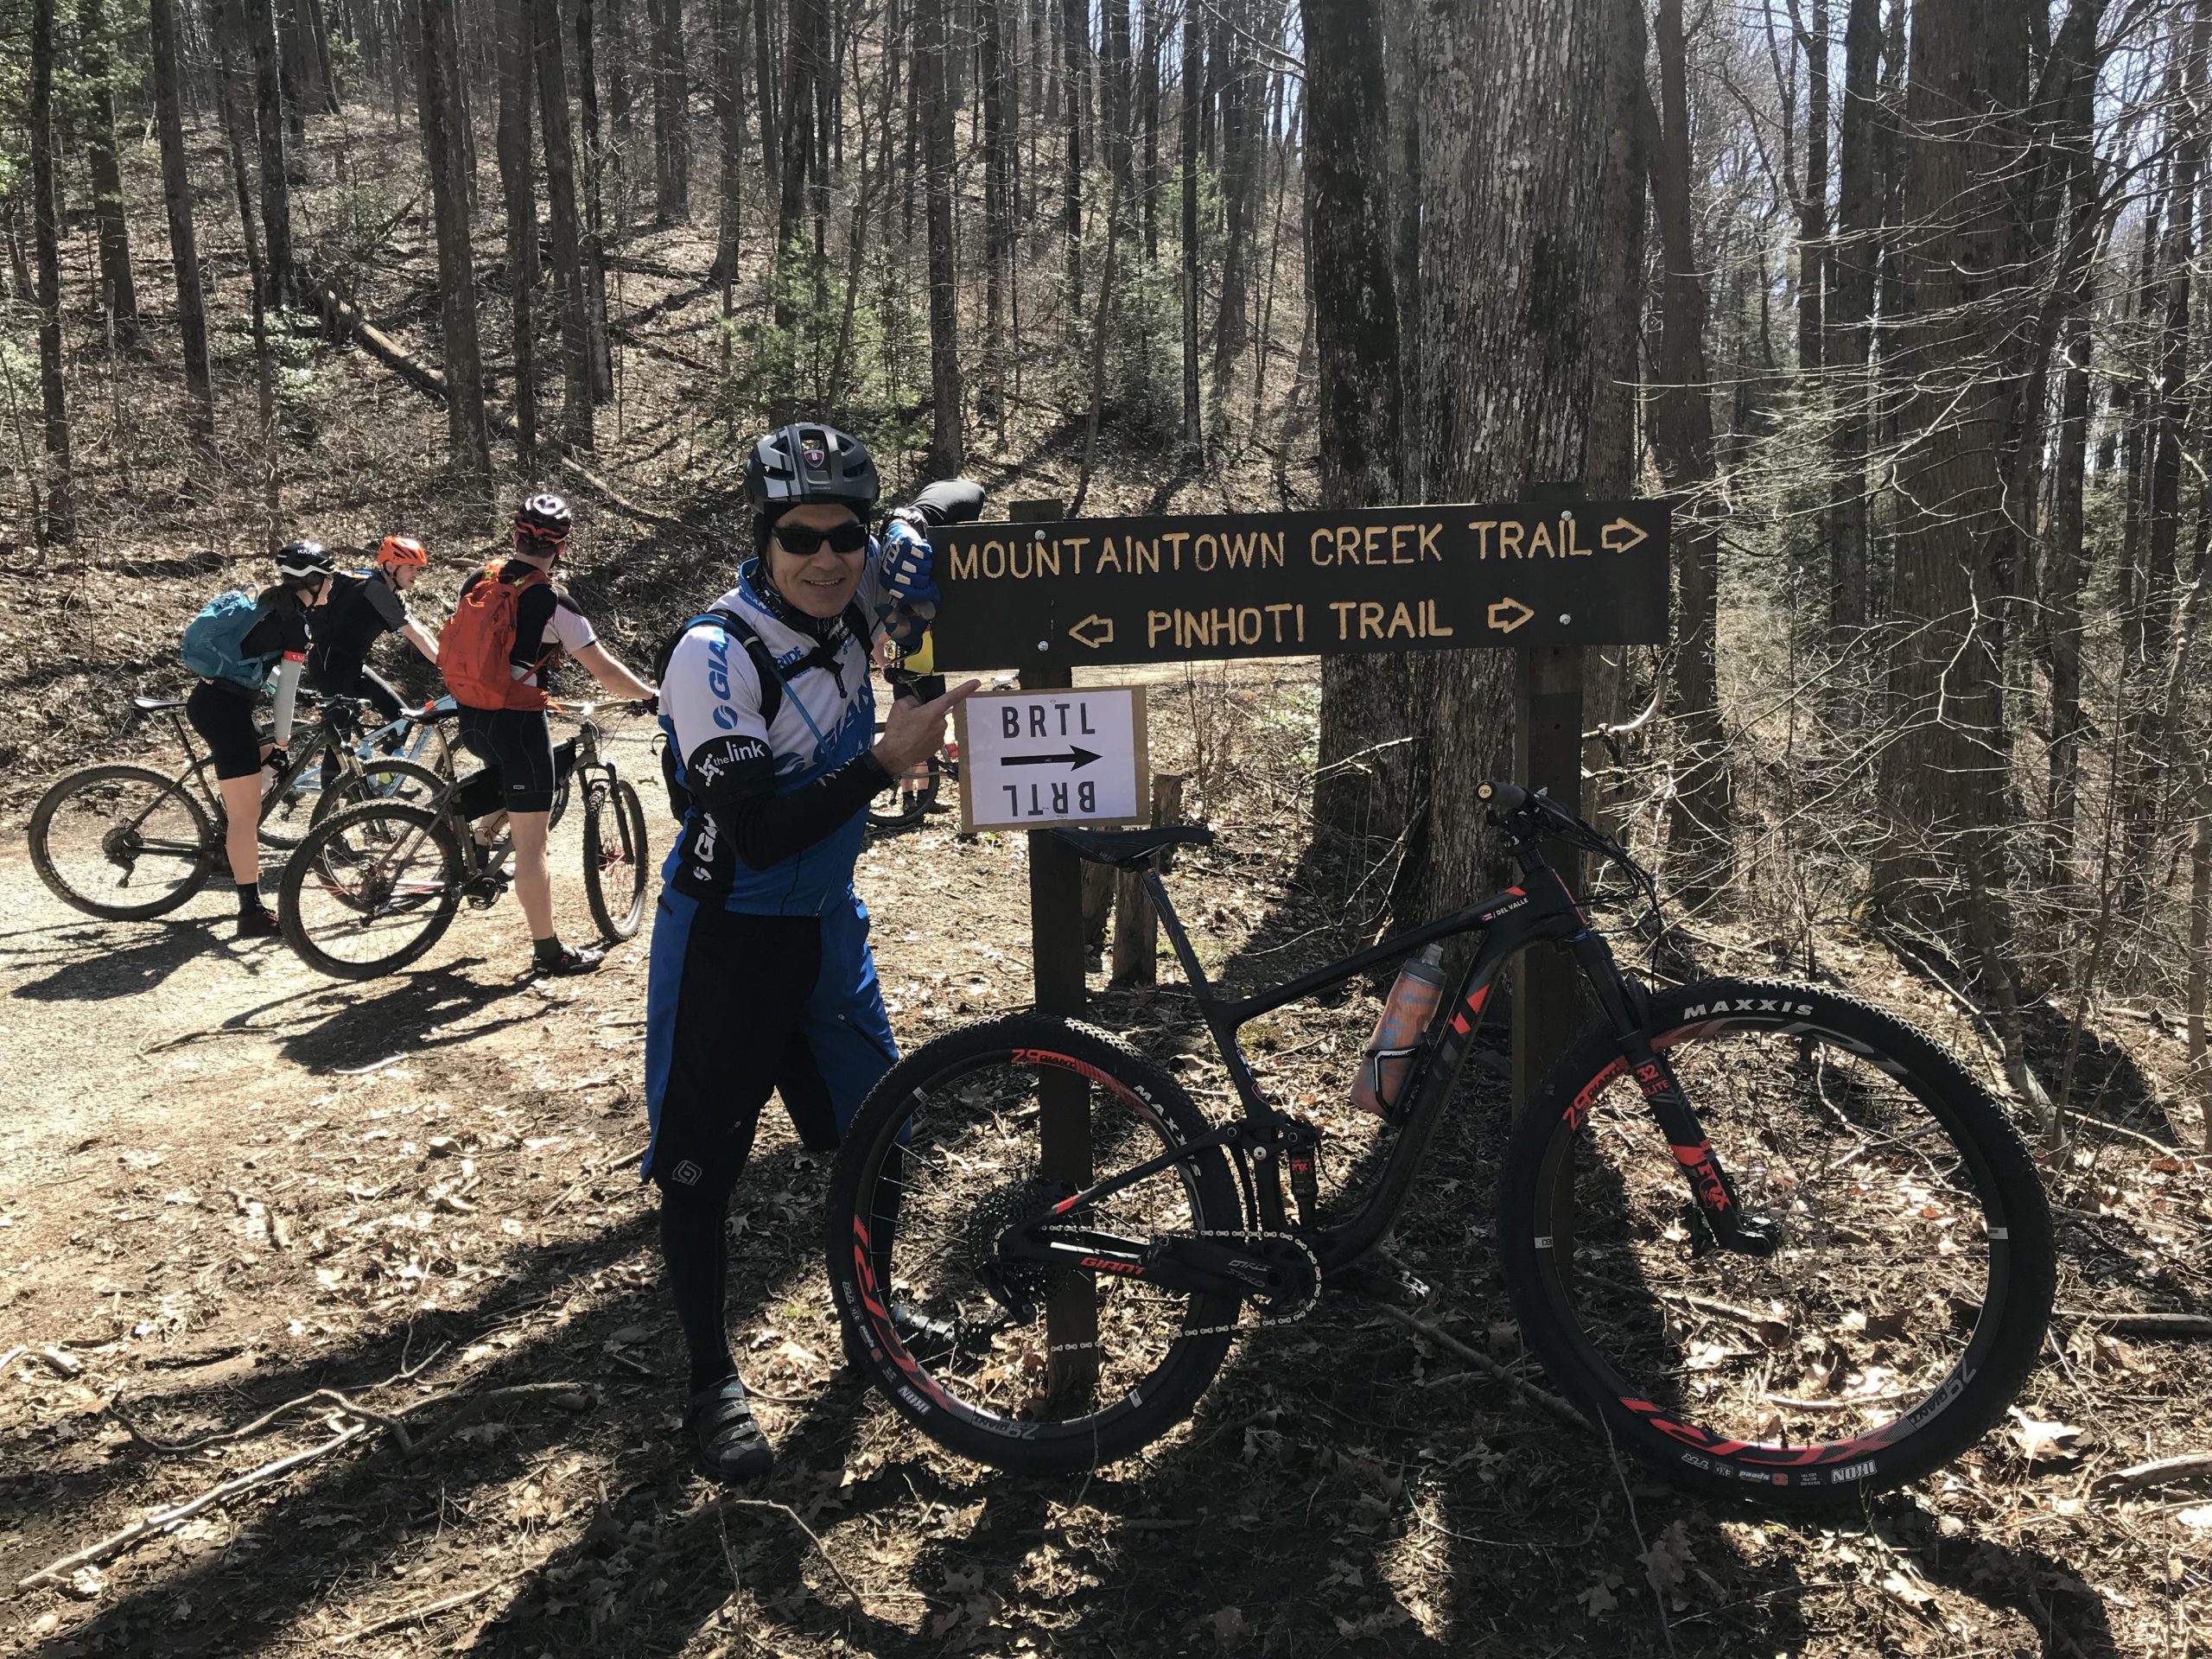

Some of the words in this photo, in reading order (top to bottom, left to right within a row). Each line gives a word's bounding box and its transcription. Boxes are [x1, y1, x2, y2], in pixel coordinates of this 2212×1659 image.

[949, 531, 1285, 582] MOUNTAINTOWN
[1311, 522, 1445, 567] CREEK
[1470, 518, 1592, 560] TRAIL
[1147, 601, 1305, 649] PINHOTI
[1329, 598, 1453, 640] TRAIL
[1001, 702, 1096, 740] BRTL
[713, 755, 730, 766] the
[725, 741, 766, 762] link
[1002, 780, 1096, 817] BRTL
[1496, 906, 1510, 917] DEL
[1509, 897, 1529, 912] VALLE
[1683, 998, 1815, 1019] MAXXIS
[1011, 1048, 1039, 1065] 29
[1636, 1064, 1660, 1083] 32
[1643, 1078, 1671, 1096] ELITE
[1562, 1091, 1592, 1131] 29
[1079, 1256, 1147, 1276] GIANT
[898, 1385, 931, 1415] IKON
[1910, 1391, 1948, 1426] GIANT
[1831, 1459, 1878, 1484] IKON
